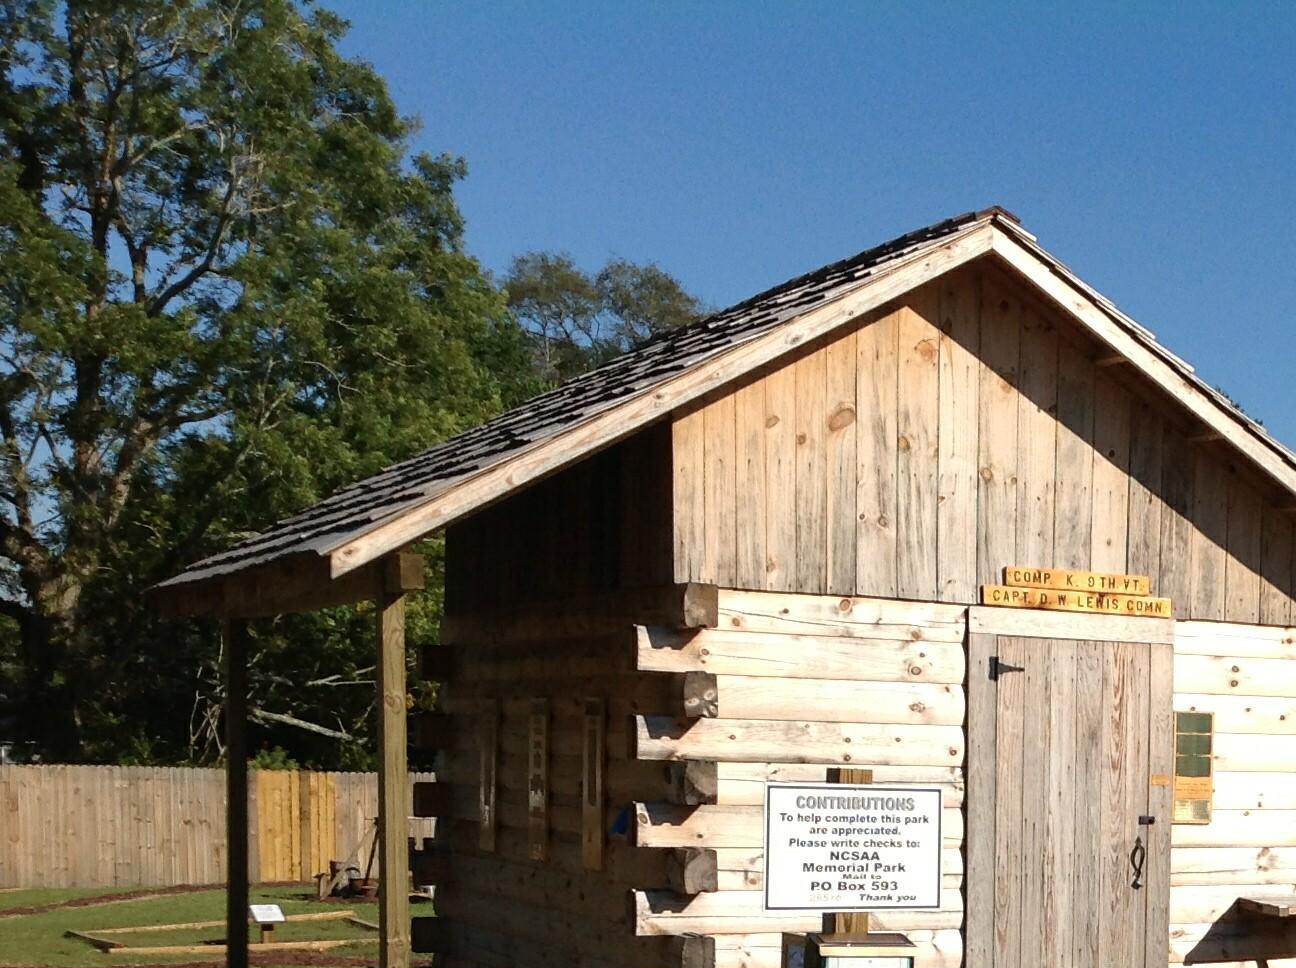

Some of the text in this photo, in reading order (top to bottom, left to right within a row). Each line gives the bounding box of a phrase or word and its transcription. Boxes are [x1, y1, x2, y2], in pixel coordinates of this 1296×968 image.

[992, 589, 1032, 604] CAPT.
[1040, 592, 1052, 605] D.
[1077, 595, 1119, 609] LEWIS
[796, 795, 915, 811] CONTRIBUTIONS
[780, 812, 929, 825] To help complete this park
[809, 825, 901, 836] are appreciated.
[789, 838, 920, 849] Please write checks to:
[829, 850, 880, 861] NCSAA
[802, 862, 906, 873] Memorial Park
[810, 881, 898, 891] PO Box 593
[859, 893, 893, 901] Thank
[896, 894, 917, 903] you
